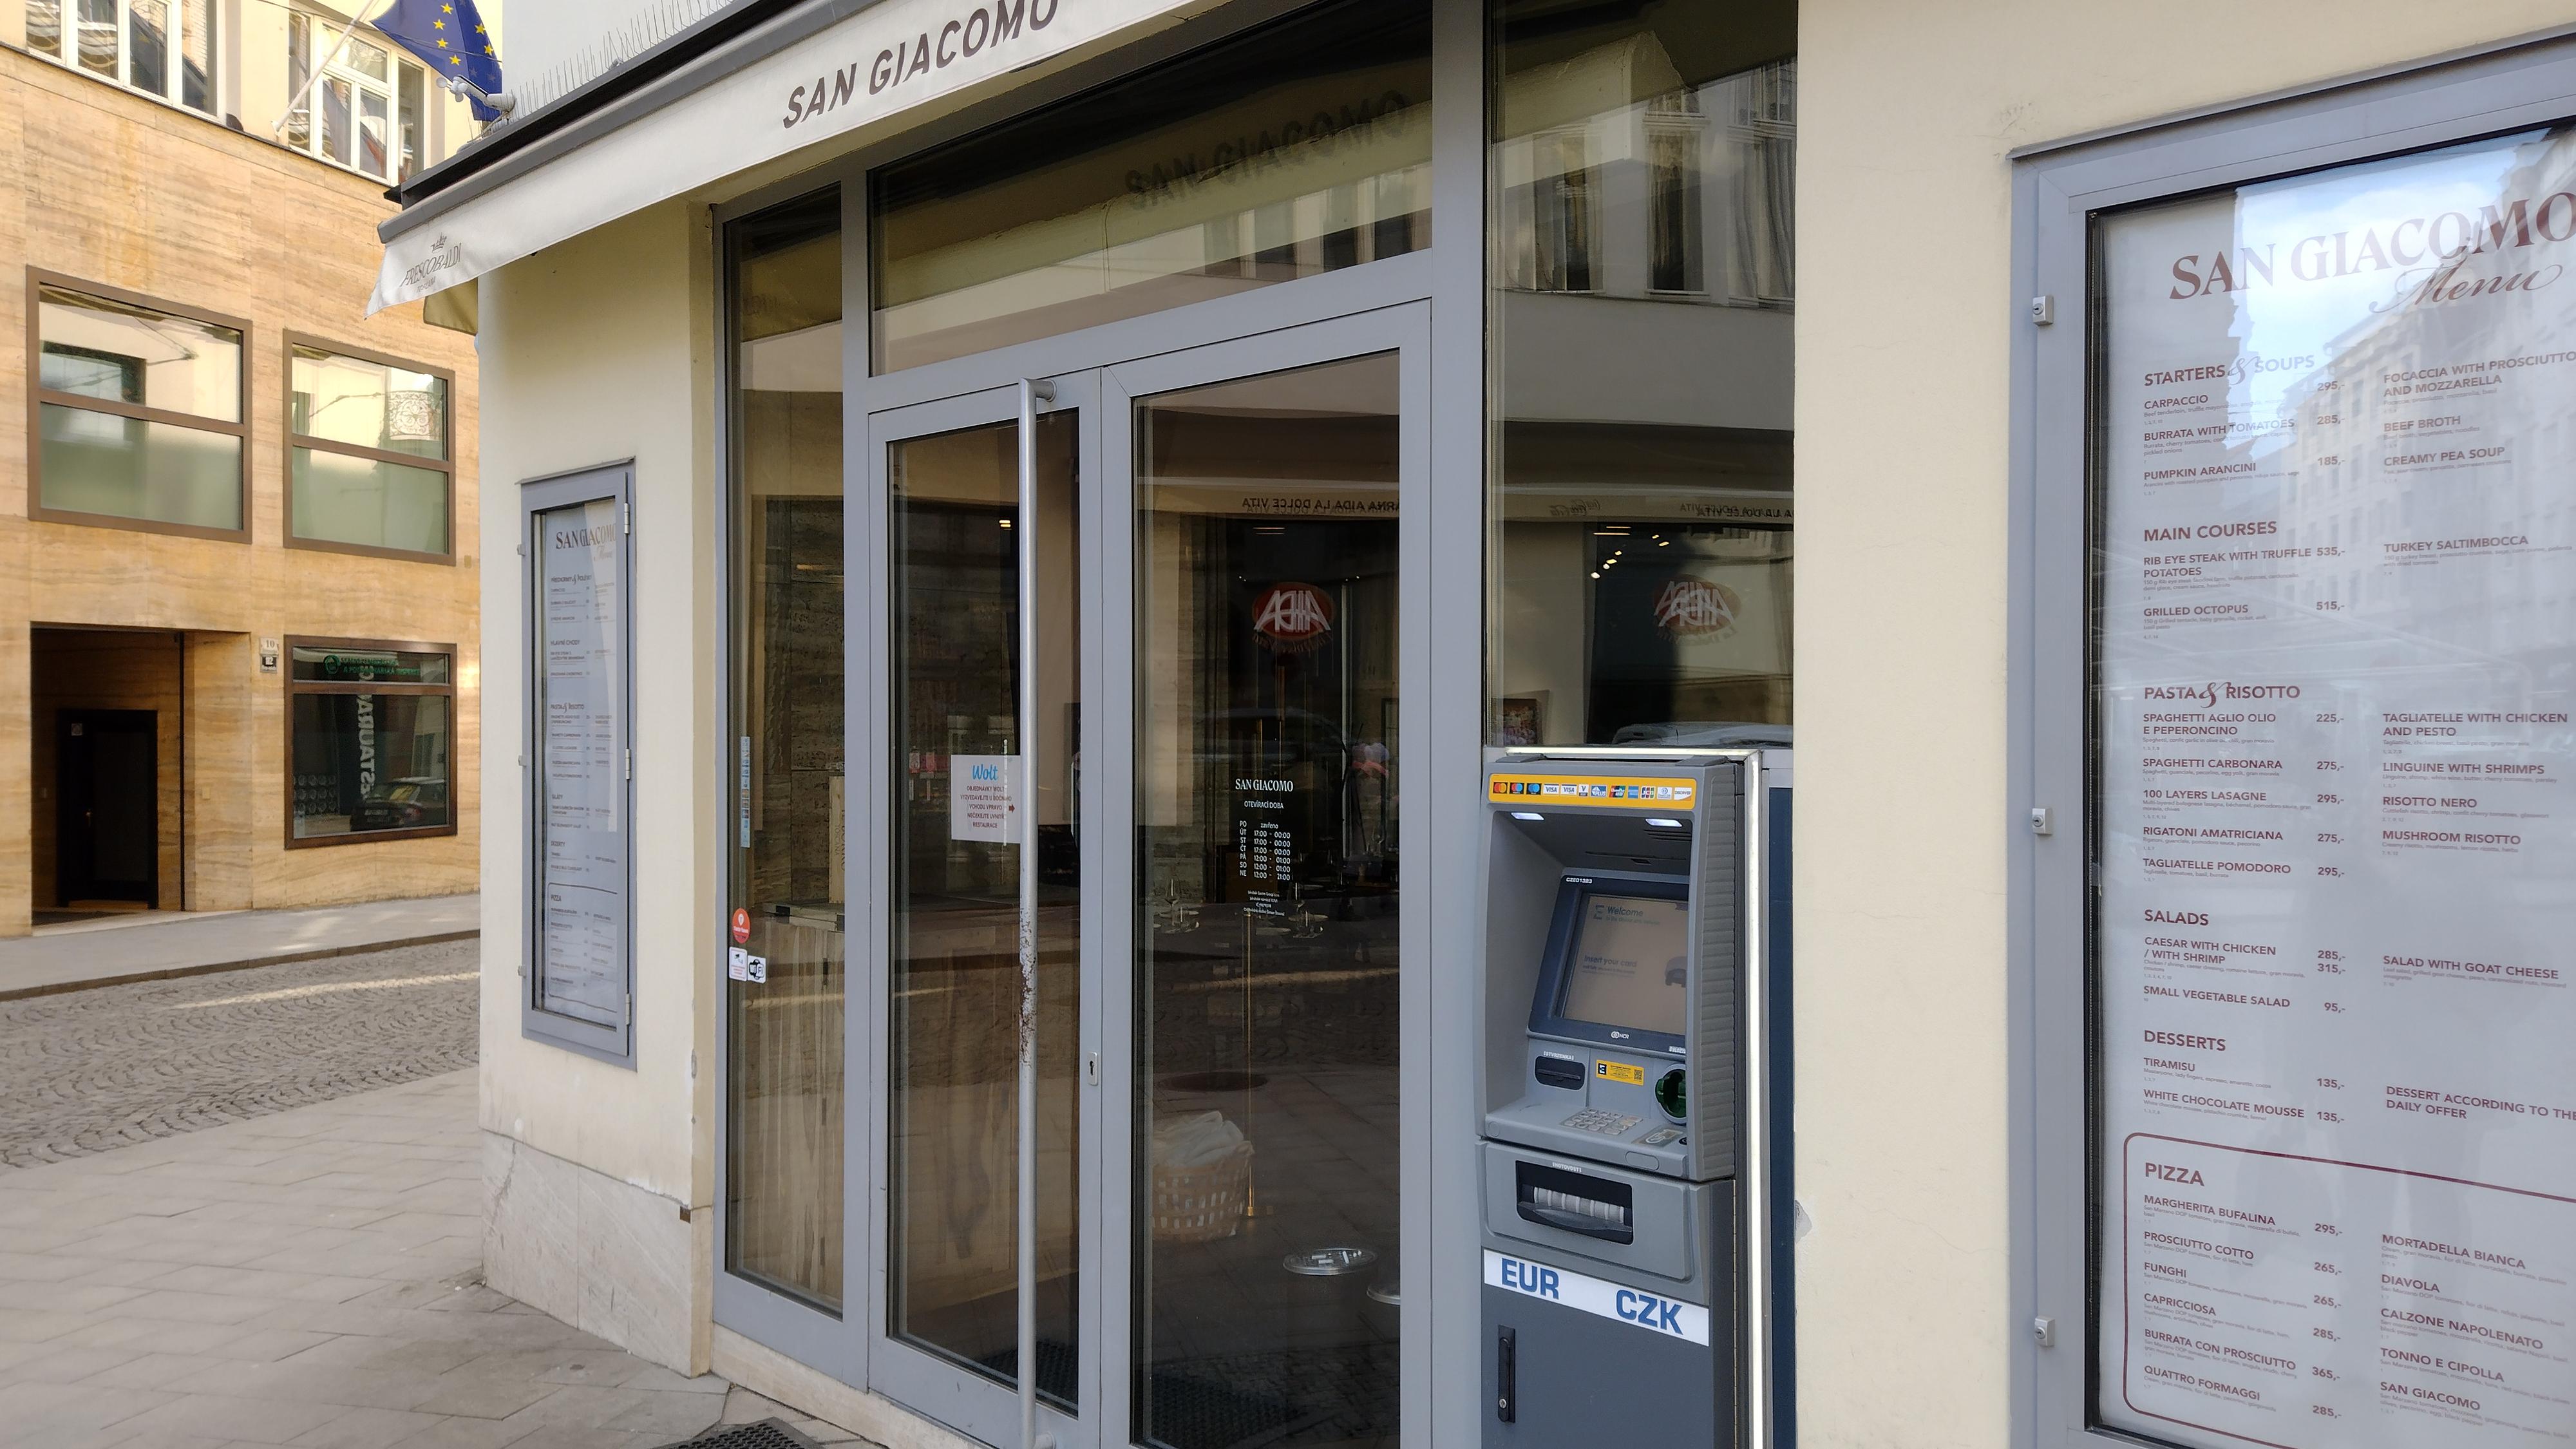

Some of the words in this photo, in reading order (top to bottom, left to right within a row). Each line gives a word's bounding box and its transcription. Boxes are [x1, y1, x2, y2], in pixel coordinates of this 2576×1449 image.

[783, 62, 857, 129] SAN
[869, 0, 1057, 95] GIACOMO
[2170, 243, 2276, 299] SAN
[2291, 192, 2576, 281] GIACOMO
[400, 242, 462, 287] FRESCOBALDI
[2369, 257, 2562, 314] Menu
[2144, 365, 2226, 386] STARTERS
[2255, 355, 2315, 374] SOUPS
[2383, 368, 2446, 384] FOCACCIA
[2452, 362, 2485, 374] WITH
[2489, 352, 2576, 370] PROSCIUTTO
[2144, 395, 2208, 409] CARPACCIO
[2318, 381, 2345, 392] 295,-
[2384, 385, 2410, 397] AND
[2415, 375, 2502, 393] MOZZARELLA
[2383, 419, 2414, 431] BEEF
[2418, 415, 2461, 428] BROTH
[2384, 453, 2436, 466] CREAMY
[2441, 450, 2465, 461] PEA
[2470, 446, 2505, 459] SOUP
[2144, 468, 2196, 480] PUMPKIN
[2201, 462, 2256, 475] ARANCINI
[556, 530, 578, 549] SAN
[2144, 526, 2190, 542] MAIN
[2197, 520, 2277, 538] COURSES
[2384, 540, 2432, 553] TURKEY
[2437, 535, 2528, 550] SALTIMBOCCA
[2144, 554, 2161, 565] RIB
[2165, 554, 2184, 565] EYE
[2188, 552, 2225, 564] STEAK
[2228, 550, 2258, 562] WITH
[2261, 547, 2311, 560] TRUFFLE
[2316, 546, 2345, 557] 535,-
[2144, 566, 2202, 578] POTATOES
[2145, 687, 2197, 699] PASTA
[2199, 681, 2233, 708] &
[2226, 686, 2300, 699] RISOTTO
[2143, 714, 2204, 723] SPAGHETTI
[2208, 713, 2245, 723] AGLIO
[2249, 713, 2276, 723] OLIO
[2316, 714, 2344, 724] 225,-
[2383, 713, 2463, 723] TAGLIATELLE
[2467, 713, 2502, 723] WITH
[2505, 713, 2568, 723] CHICKEN
[2143, 726, 2148, 735] E
[2154, 726, 2237, 735] PEPERONCINO
[2383, 727, 2410, 736] AND
[2416, 727, 2456, 737] PESTO
[972, 764, 998, 781] Wolt
[2143, 759, 2204, 769] SPAGHETTI
[2208, 759, 2282, 770] CARBONARA
[1235, 779, 1251, 790] SAN
[1253, 780, 1293, 791] GIACOMO
[2144, 790, 2162, 799] 100
[2166, 791, 2208, 800] LAYERS
[2211, 791, 2266, 802] LASAGNE
[2383, 831, 2460, 844] MUSHROOM
[2465, 833, 2521, 846] RISOTTO
[1607, 906, 1643, 917] Welcome
[2145, 909, 2209, 927] SALADS
[2145, 937, 2187, 949] CAESAR
[2191, 940, 2219, 951] WITH
[2223, 942, 2276, 956] CHICKEN
[2318, 950, 2345, 961] 285,-
[2152, 949, 2179, 961] WITH
[2183, 952, 2225, 964] SHRIMP
[1584, 955, 1603, 964] Insert
[2383, 956, 2423, 969] SALAD
[2428, 959, 2461, 972] WITH
[2465, 962, 2501, 976] GOAT
[2506, 965, 2559, 980] CHEESE
[2144, 1030, 2226, 1052] DESSERTS
[2144, 1057, 2195, 1072] TIRAMISU
[2386, 1086, 2440, 1103] DESSERT
[2444, 1093, 2525, 1115] ACCORDING
[2529, 1104, 2549, 1118] TO
[2553, 1108, 2576, 1122] THE
[2386, 1099, 2421, 1114] DAILY
[2425, 1104, 2467, 1120] OFFER
[2145, 1162, 2204, 1188] PIZZA
[2145, 1195, 2215, 1216] MARGHERITA
[2219, 1207, 2276, 1226] BUFALINA
[2315, 1223, 2343, 1236] 295,-
[2145, 1231, 2212, 1252] PROSCIUTTO
[2215, 1244, 2254, 1260] COTTO
[2382, 1234, 2470, 1258] MORTADELLA
[2474, 1250, 2525, 1270] BIANCA
[2145, 1262, 2186, 1278] FUNGHI
[2382, 1274, 2439, 1293] DIAVOLA
[1502, 1258, 1559, 1300] EUR
[1616, 1289, 1683, 1336] CZK
[2145, 1293, 2217, 1317] CAPRICCIOSA
[2145, 1329, 2192, 1348] BURRATA
[2195, 1341, 2220, 1355] CON
[2224, 1347, 2296, 1370] PROSCIUTTO
[2312, 1367, 2340, 1381] 365,-
[2380, 1382, 2408, 1397] SAN
[2412, 1388, 2481, 1411] GIACOMO
